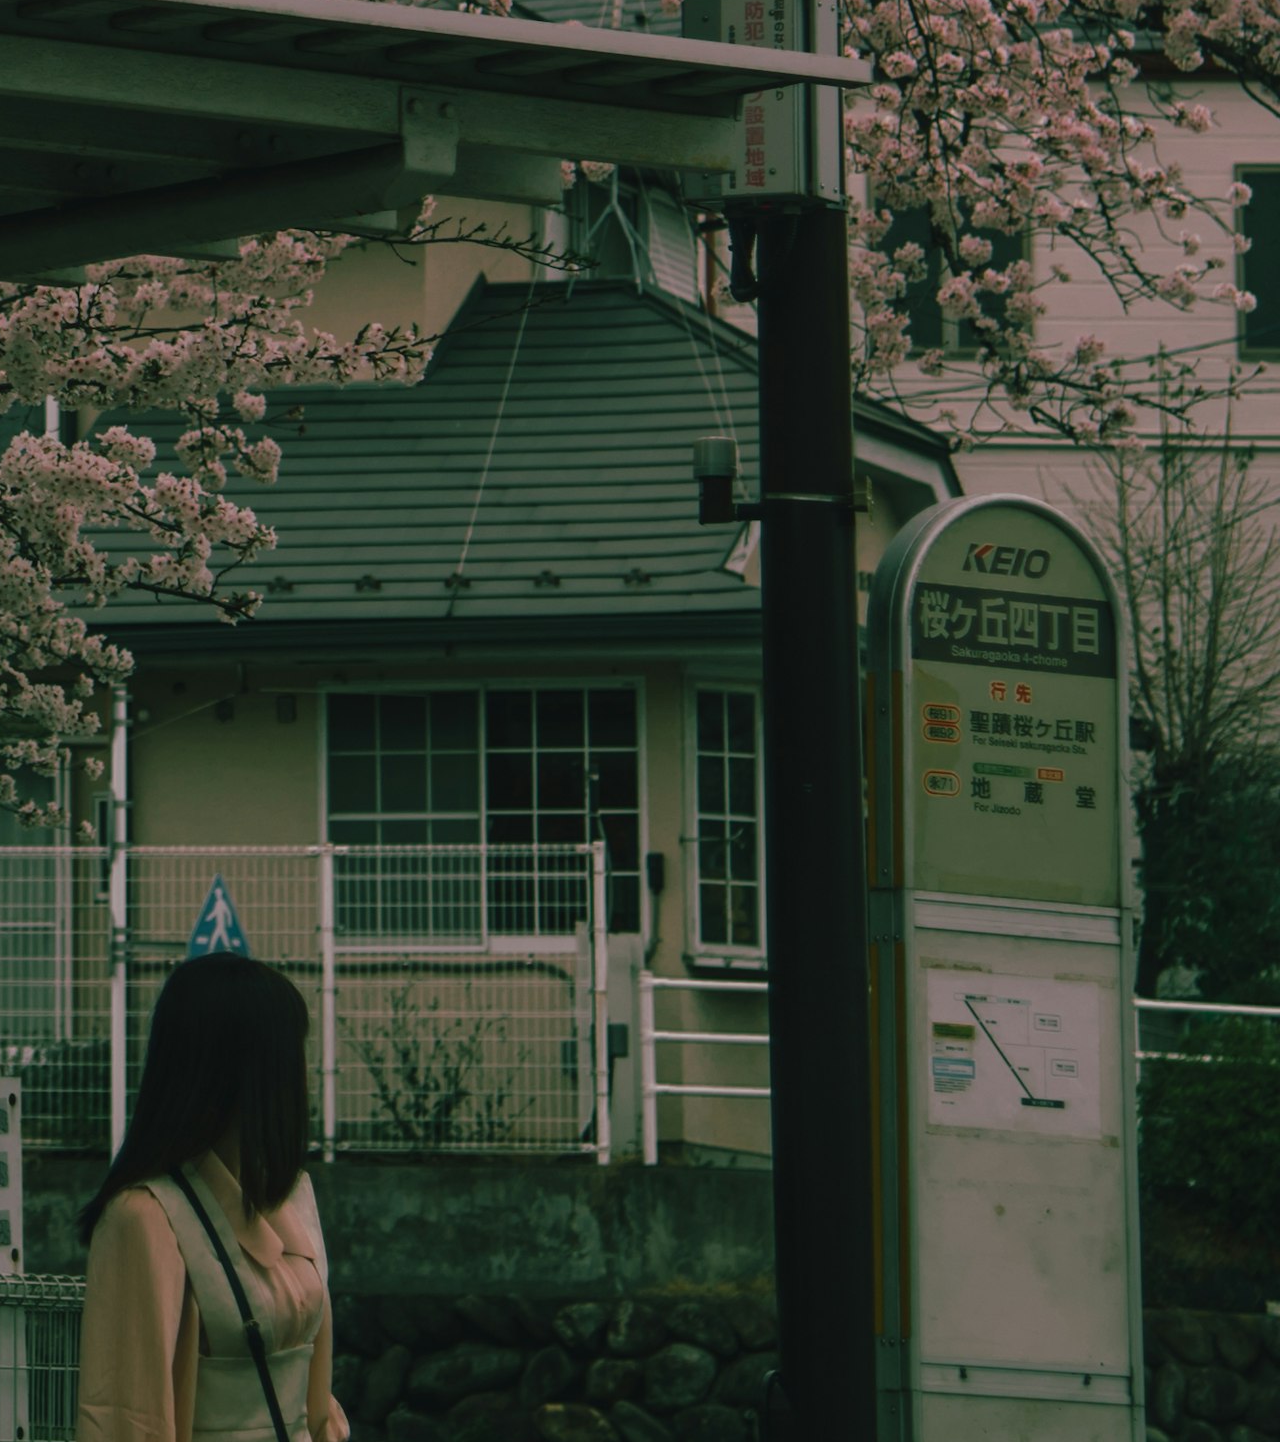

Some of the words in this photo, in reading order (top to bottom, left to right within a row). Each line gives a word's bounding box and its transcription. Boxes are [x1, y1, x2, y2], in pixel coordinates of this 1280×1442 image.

[962, 543, 1051, 579] KEIO
[951, 644, 1020, 666] Sakuragaoka
[1022, 650, 1068, 668] 4-chome
[972, 735, 986, 745] For
[974, 801, 989, 813] For
[990, 803, 1021, 816] Jizodo
